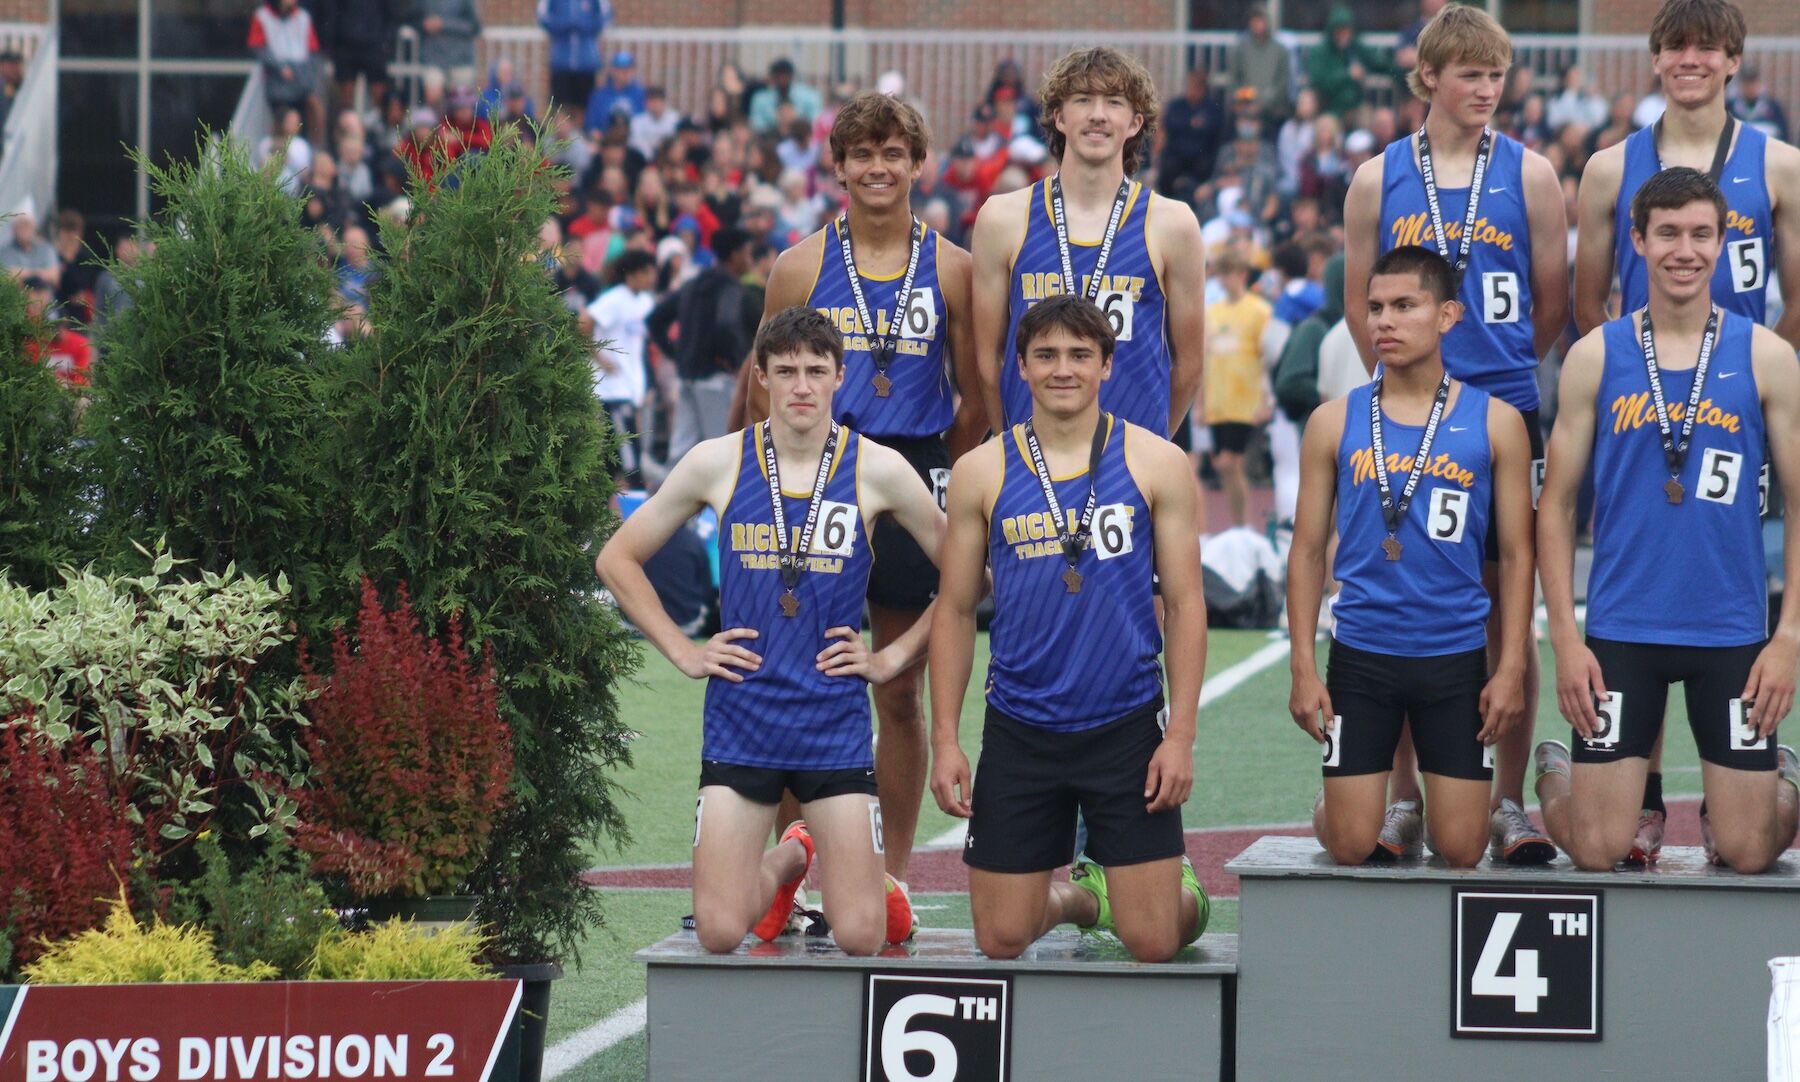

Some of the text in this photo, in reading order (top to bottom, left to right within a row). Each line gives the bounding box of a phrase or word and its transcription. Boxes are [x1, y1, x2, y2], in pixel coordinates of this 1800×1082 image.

[1054, 198, 1064, 224] STATE
[1421, 155, 1448, 256] STATE CHAMPIONSHIPS
[1460, 155, 1487, 255] STATE CHAMPIONSHIPS
[1088, 200, 1124, 298] STATE CHAMPIONSHIPS
[1392, 212, 1513, 251] Mauton
[842, 239, 874, 335] STATE CHAMPIONSHIPS
[890, 240, 919, 335] STATE CHAMPIONSHIPS
[1021, 272, 1066, 300] RIC
[1738, 242, 1757, 288] 5
[906, 291, 928, 335] 6
[1103, 293, 1124, 338] 6
[1492, 276, 1511, 321] 5
[1643, 331, 1670, 434] STATE CHAMPIONSHIPS
[1682, 332, 1713, 435] STATE CHAMPIONSHIPS
[1612, 391, 1740, 435] Mauton
[1350, 447, 1474, 487] Mauton
[1373, 420, 1389, 492] CHAMPIONSHIPS
[1404, 401, 1443, 496] STATE CHAMPIONSHIPS
[766, 447, 788, 550] STATE CHAMPIONSHIPS
[1028, 436, 1064, 528] STATE CHAMPIONSHIPS
[1706, 453, 1734, 499] 5
[799, 451, 833, 553] STATE CHAMPIONSHIPS
[1436, 492, 1461, 538] 5
[823, 505, 848, 550] 6
[1099, 508, 1124, 554] 6
[26, 1033, 455, 1082] BOYS DIVISION 2
